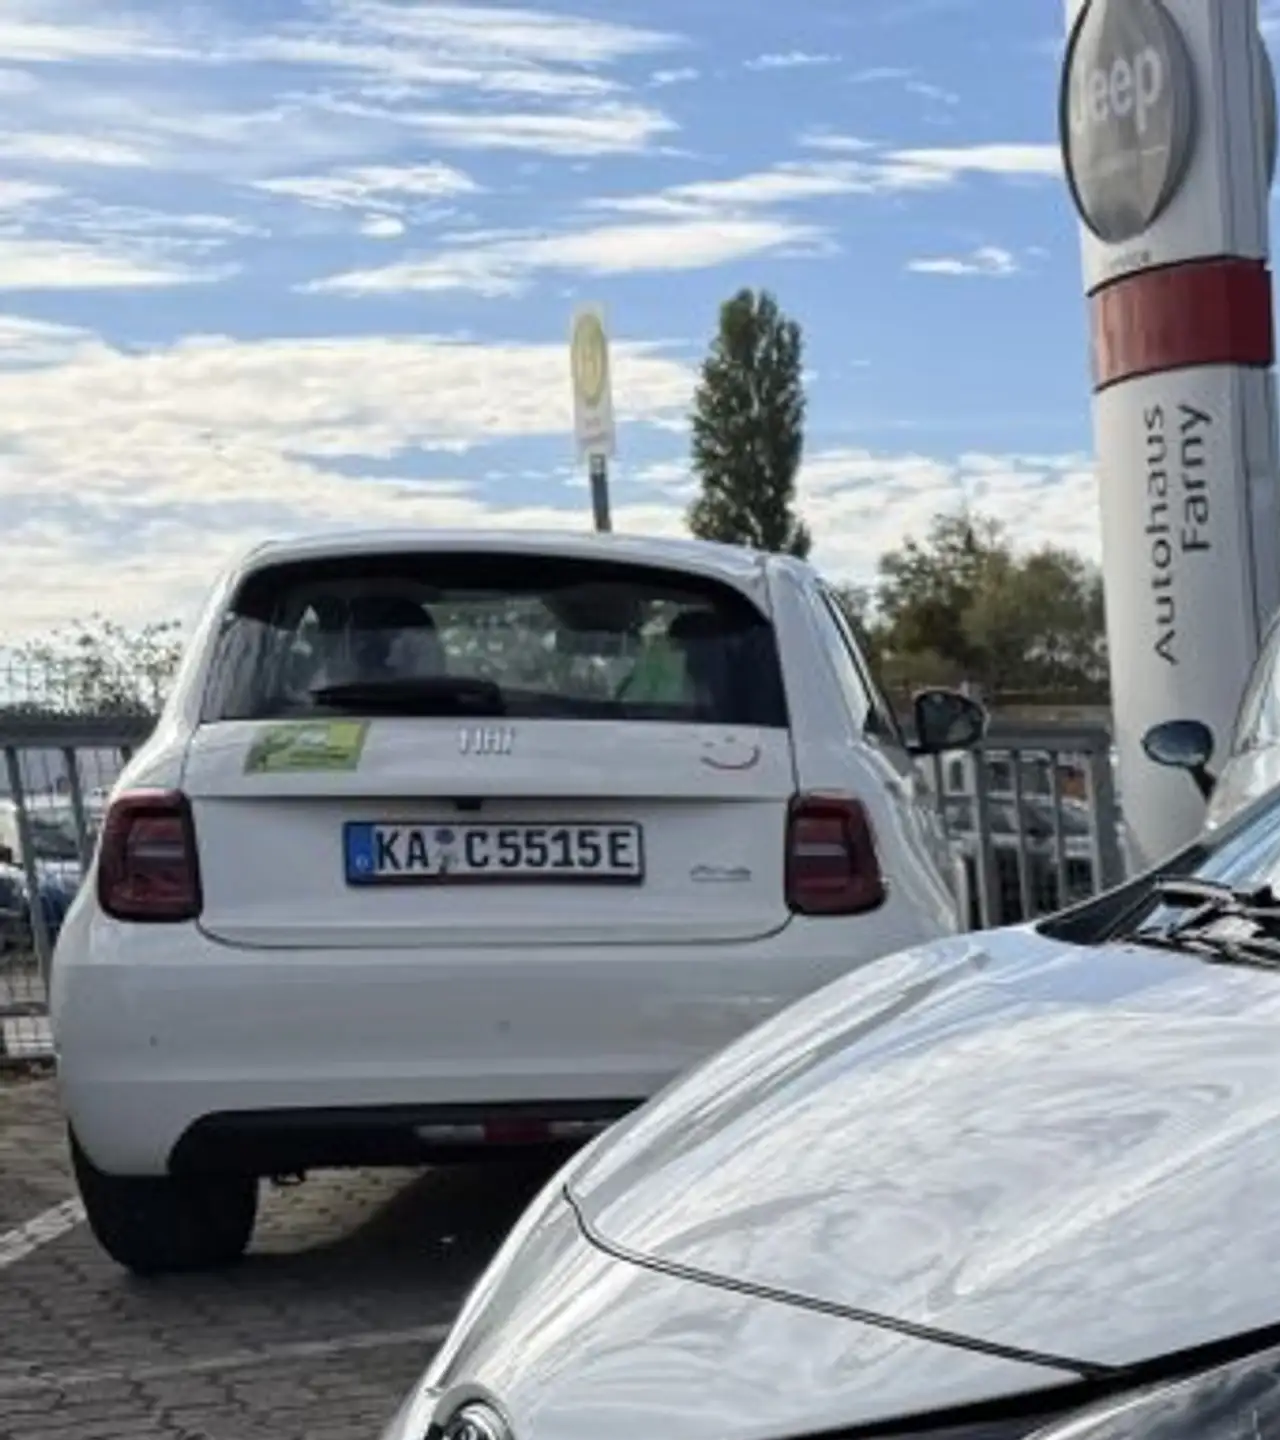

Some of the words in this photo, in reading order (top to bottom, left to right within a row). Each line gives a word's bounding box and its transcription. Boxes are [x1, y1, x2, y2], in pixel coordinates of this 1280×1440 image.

[1072, 45, 1162, 134] Jeep
[1144, 403, 1179, 666] Autohaus
[1177, 402, 1213, 555] Farny
[376, 829, 430, 869] KA
